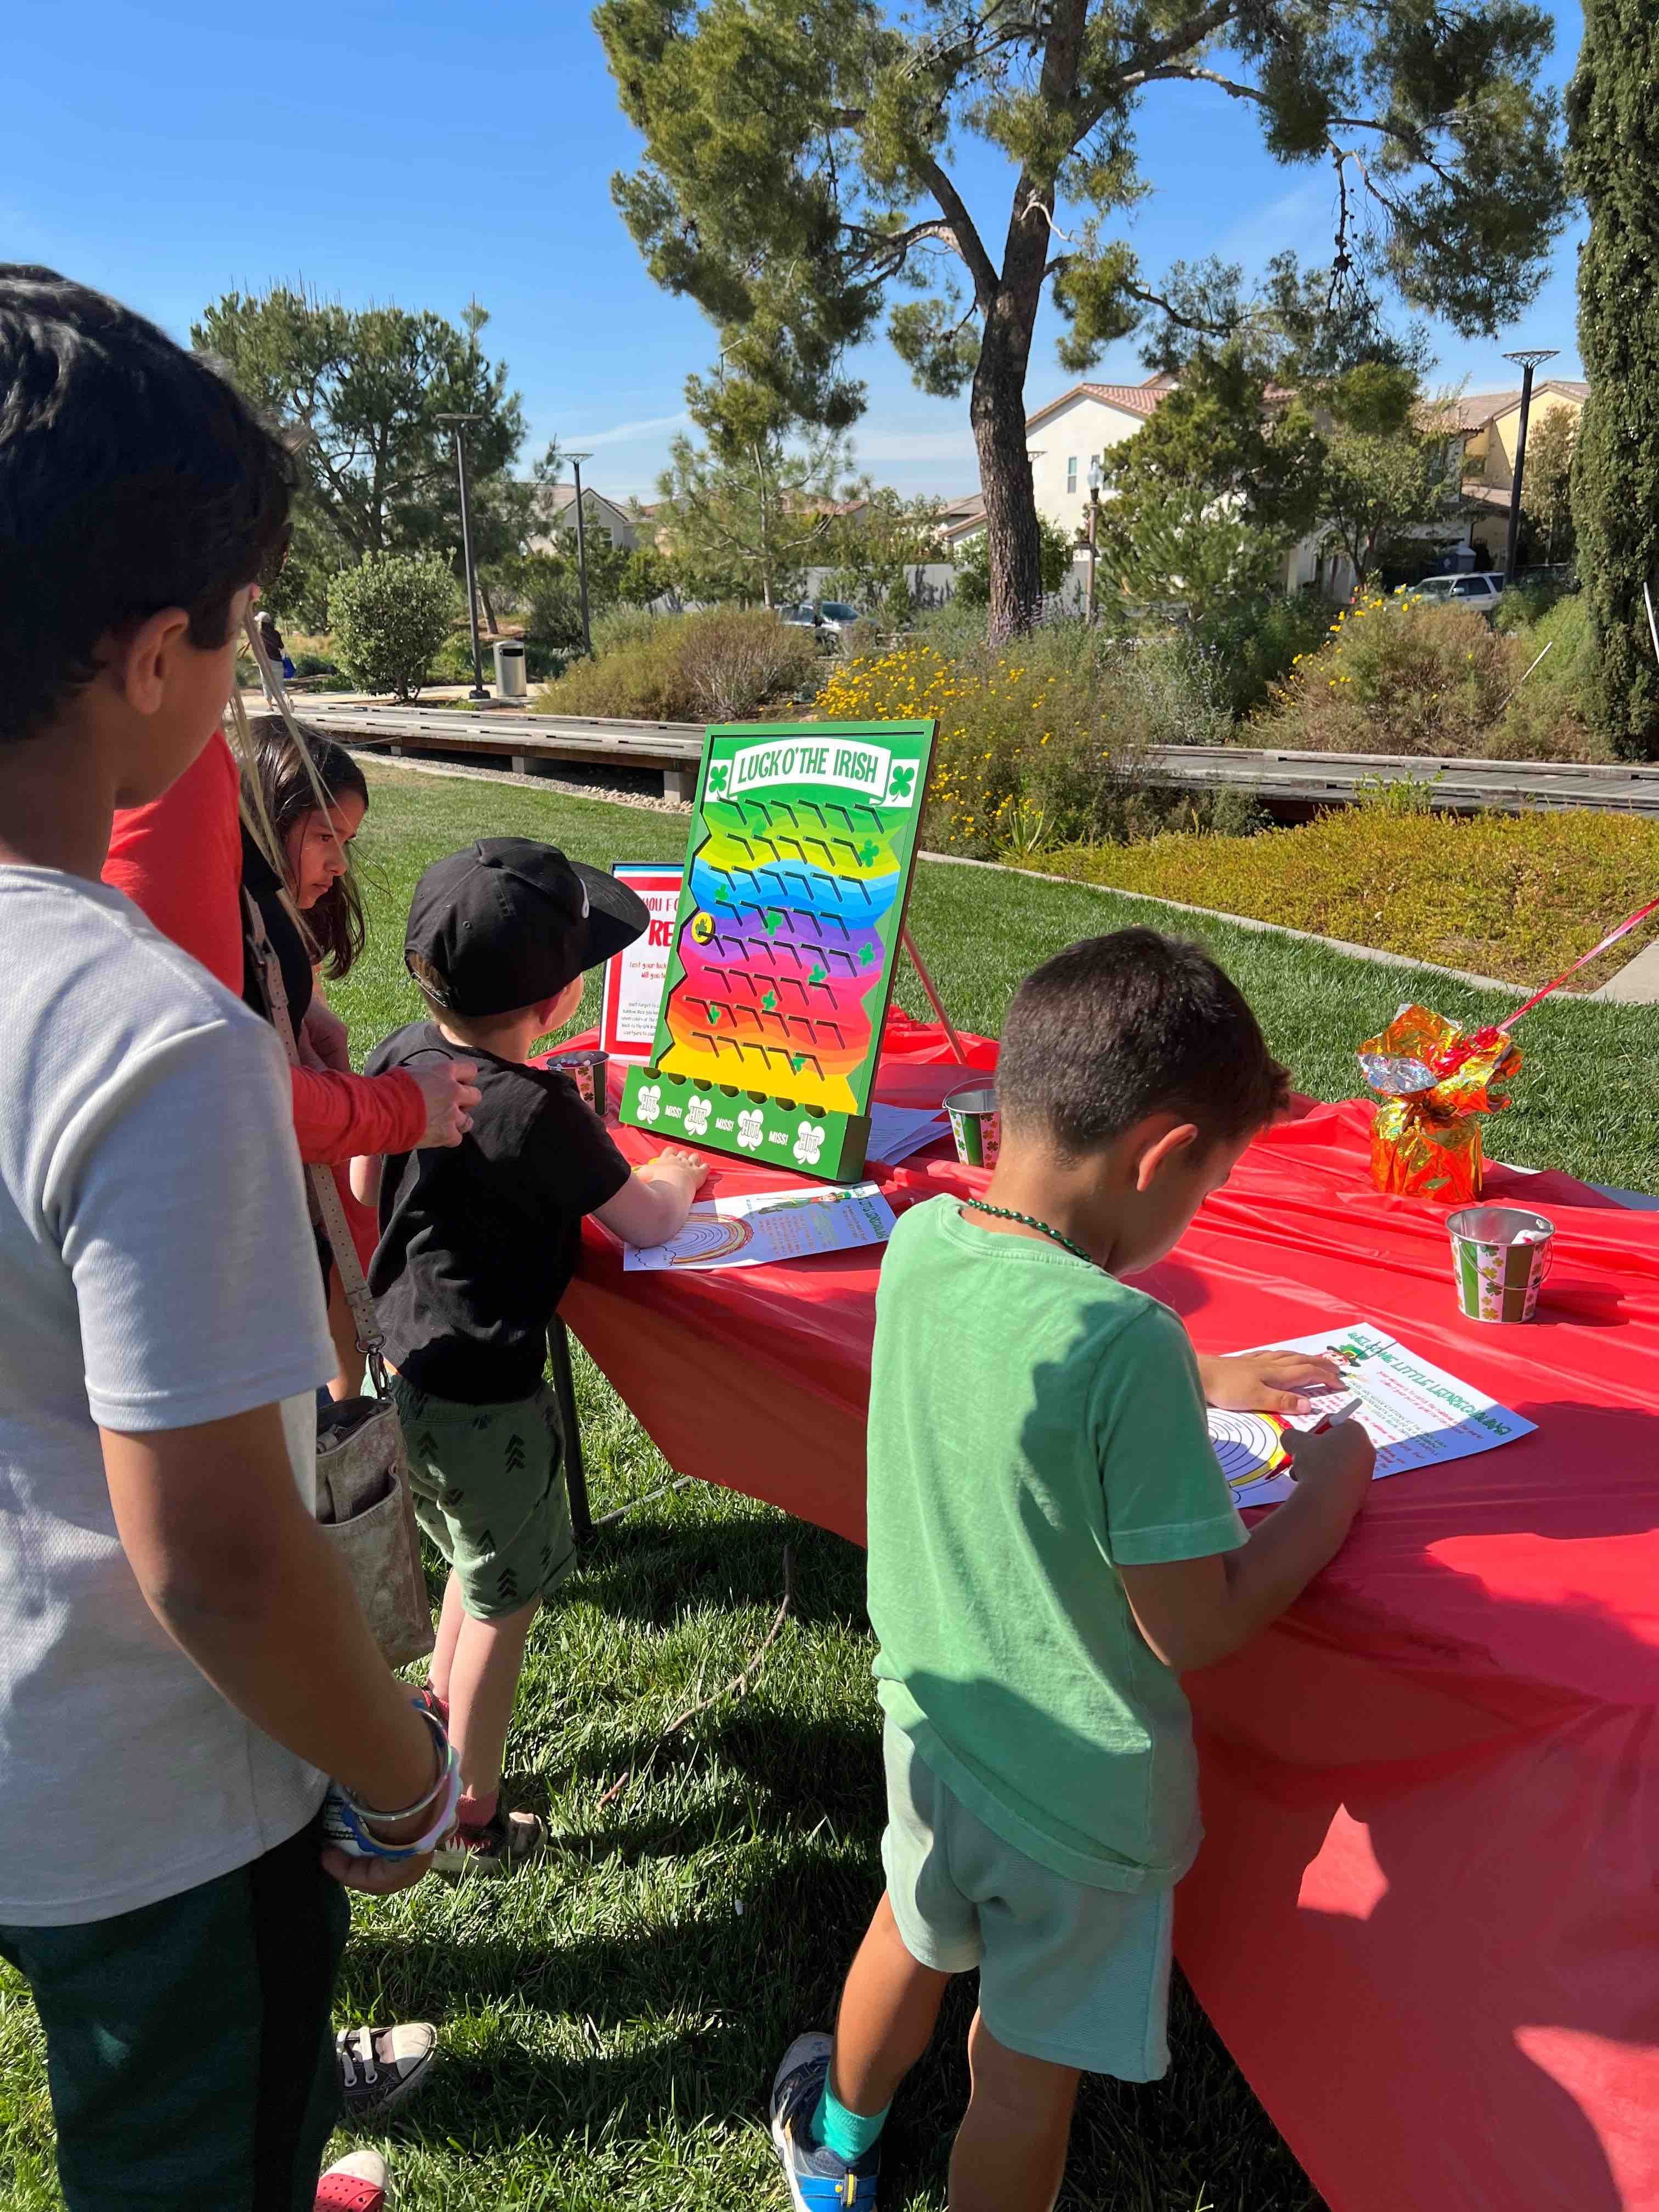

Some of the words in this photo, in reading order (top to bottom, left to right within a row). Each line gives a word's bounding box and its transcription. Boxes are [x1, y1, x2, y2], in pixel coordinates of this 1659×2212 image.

[738, 749, 782, 784] LUCK
[833, 749, 878, 783] IRISH
[640, 1094, 658, 1113] HIT!
[665, 1105, 683, 1119] MISS!
[689, 1106, 707, 1125] HIT!
[715, 1118, 735, 1132] MISS!
[741, 1119, 761, 1139] HIT!
[769, 1131, 789, 1146] MISS!
[799, 1132, 820, 1154] HIT!
[1391, 1362, 1434, 1386] LITTLE
